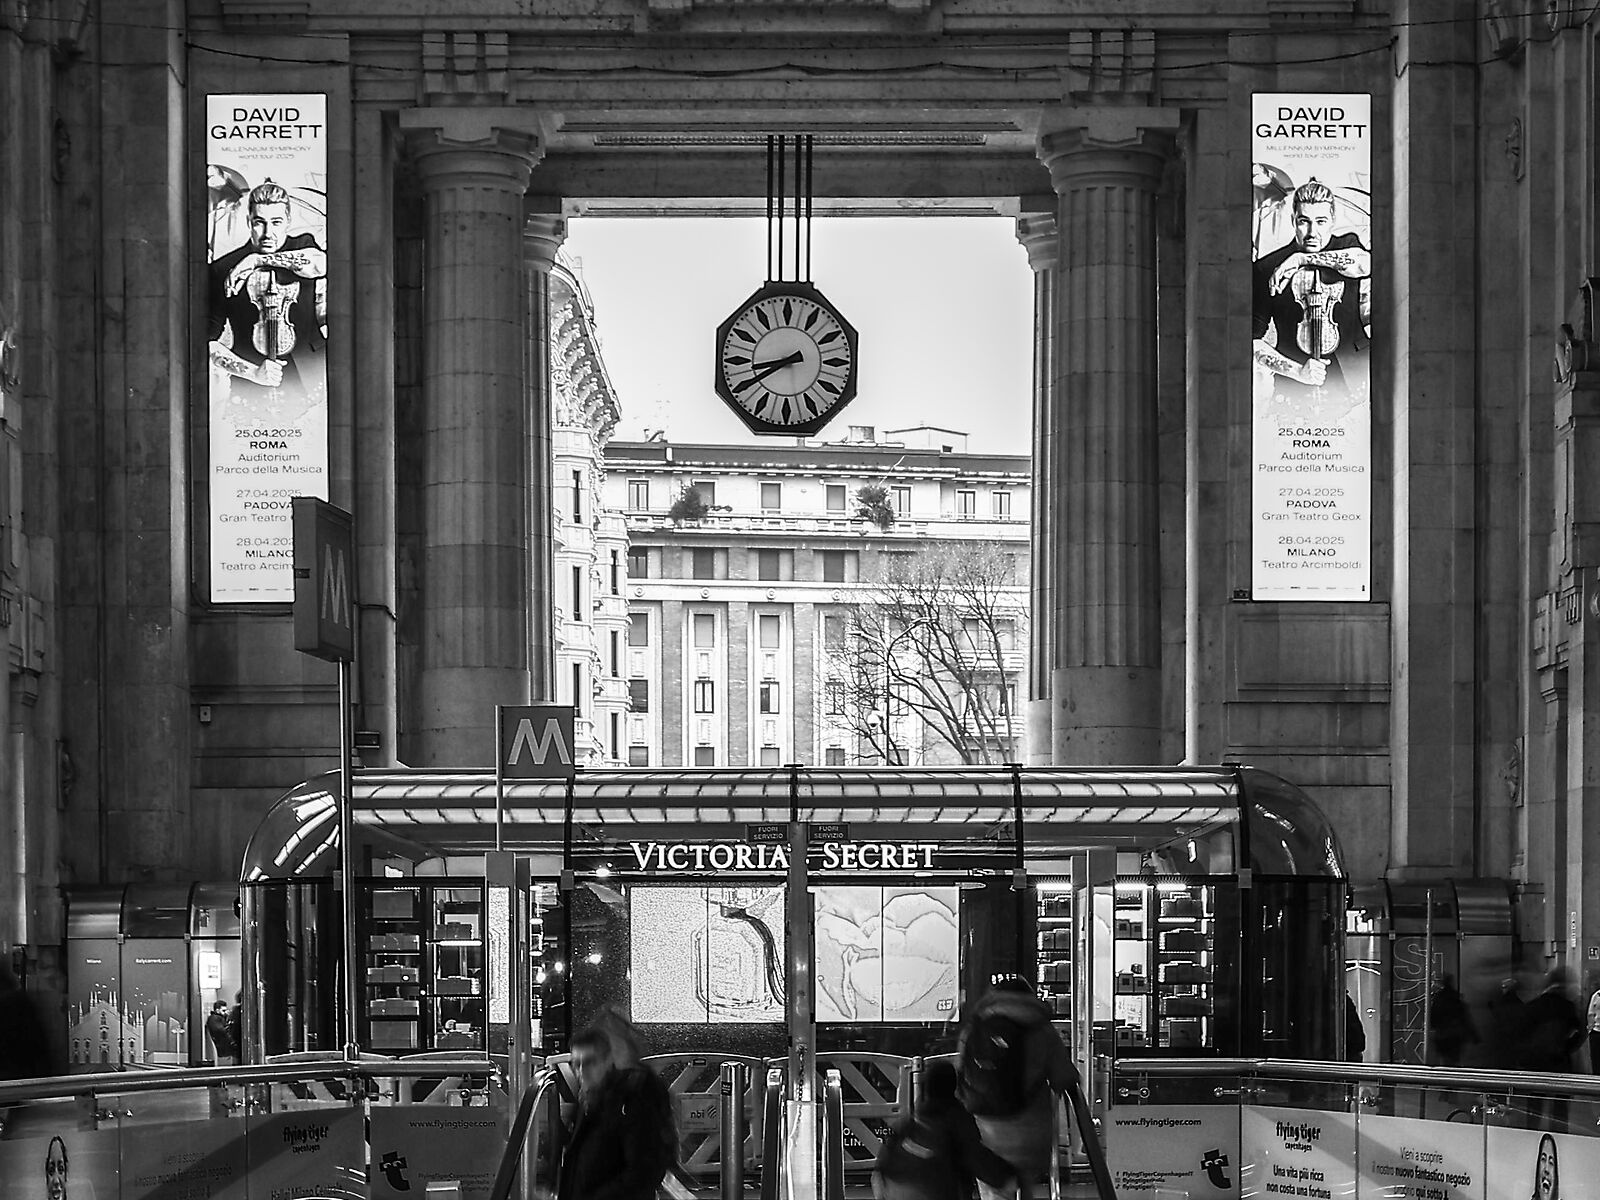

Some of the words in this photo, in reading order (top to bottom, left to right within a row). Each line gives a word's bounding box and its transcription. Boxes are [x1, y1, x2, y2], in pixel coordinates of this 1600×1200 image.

[233, 108, 300, 122] DAVID
[1278, 107, 1345, 121] DAVID
[210, 124, 322, 140] GARRETT
[1255, 123, 1367, 138] GARRETT
[235, 429, 302, 438] 25.04.2025
[1278, 428, 1345, 436] 25.04.2025
[249, 441, 287, 449] ROMA
[1292, 440, 1331, 448] ROMA
[238, 453, 300, 461] Auditorium
[1280, 452, 1343, 460] Auditorium
[215, 465, 249, 474] Parco
[252, 465, 279, 474] della
[282, 465, 322, 473] Musica
[1258, 464, 1292, 473] Parco
[1295, 464, 1321, 472] della
[1325, 464, 1365, 472] Musica
[236, 489, 302, 498] 27.04.2025
[1279, 488, 1344, 497] 27.04.2025
[1286, 500, 1337, 509] PADOVA
[219, 513, 247, 522] Gran
[251, 513, 287, 522] Teatro
[1261, 512, 1289, 521] Gran
[1293, 512, 1329, 521] Teatro
[1332, 512, 1361, 521] Geox
[236, 537, 293, 546] 28.04.202
[1278, 536, 1345, 545] 28.04.2025
[245, 550, 294, 558] MILANO
[1287, 548, 1336, 557] MILANO
[219, 562, 256, 571] Teatro
[1261, 560, 1298, 569] Teatro
[1301, 560, 1361, 569] Arcimboldi
[507, 718, 572, 765] M
[822, 841, 939, 870] SECRET
[408, 1120, 496, 1129] www.flyingtiger.com
[1115, 1118, 1202, 1128] www.flyingtiger.com
[283, 1125, 307, 1145] flying
[307, 1123, 329, 1143] tiger
[1276, 1121, 1300, 1142] flying
[1300, 1123, 1321, 1144] tiger
[1284, 1142, 1312, 1153] copenhagen
[1400, 1147, 1415, 1160] Vieni
[1415, 1152, 1420, 1161] a
[1420, 1151, 1443, 1166] scoprire
[1273, 1164, 1286, 1177] Una
[1286, 1166, 1298, 1179] vita
[1299, 1167, 1309, 1183] più
[1310, 1168, 1324, 1182] ricca
[1376, 1165, 1394, 1176] nostro
[1395, 1167, 1415, 1179] nuovo
[1415, 1165, 1445, 1183] fantastico
[1445, 1172, 1471, 1189] negozio
[1266, 1183, 1279, 1193] non
[1280, 1184, 1295, 1195] costa
[1296, 1187, 1308, 1197] una
[1309, 1185, 1331, 1199] fortuna
[1416, 1186, 1426, 1200] qui
[1427, 1188, 1443, 1200] sotto
